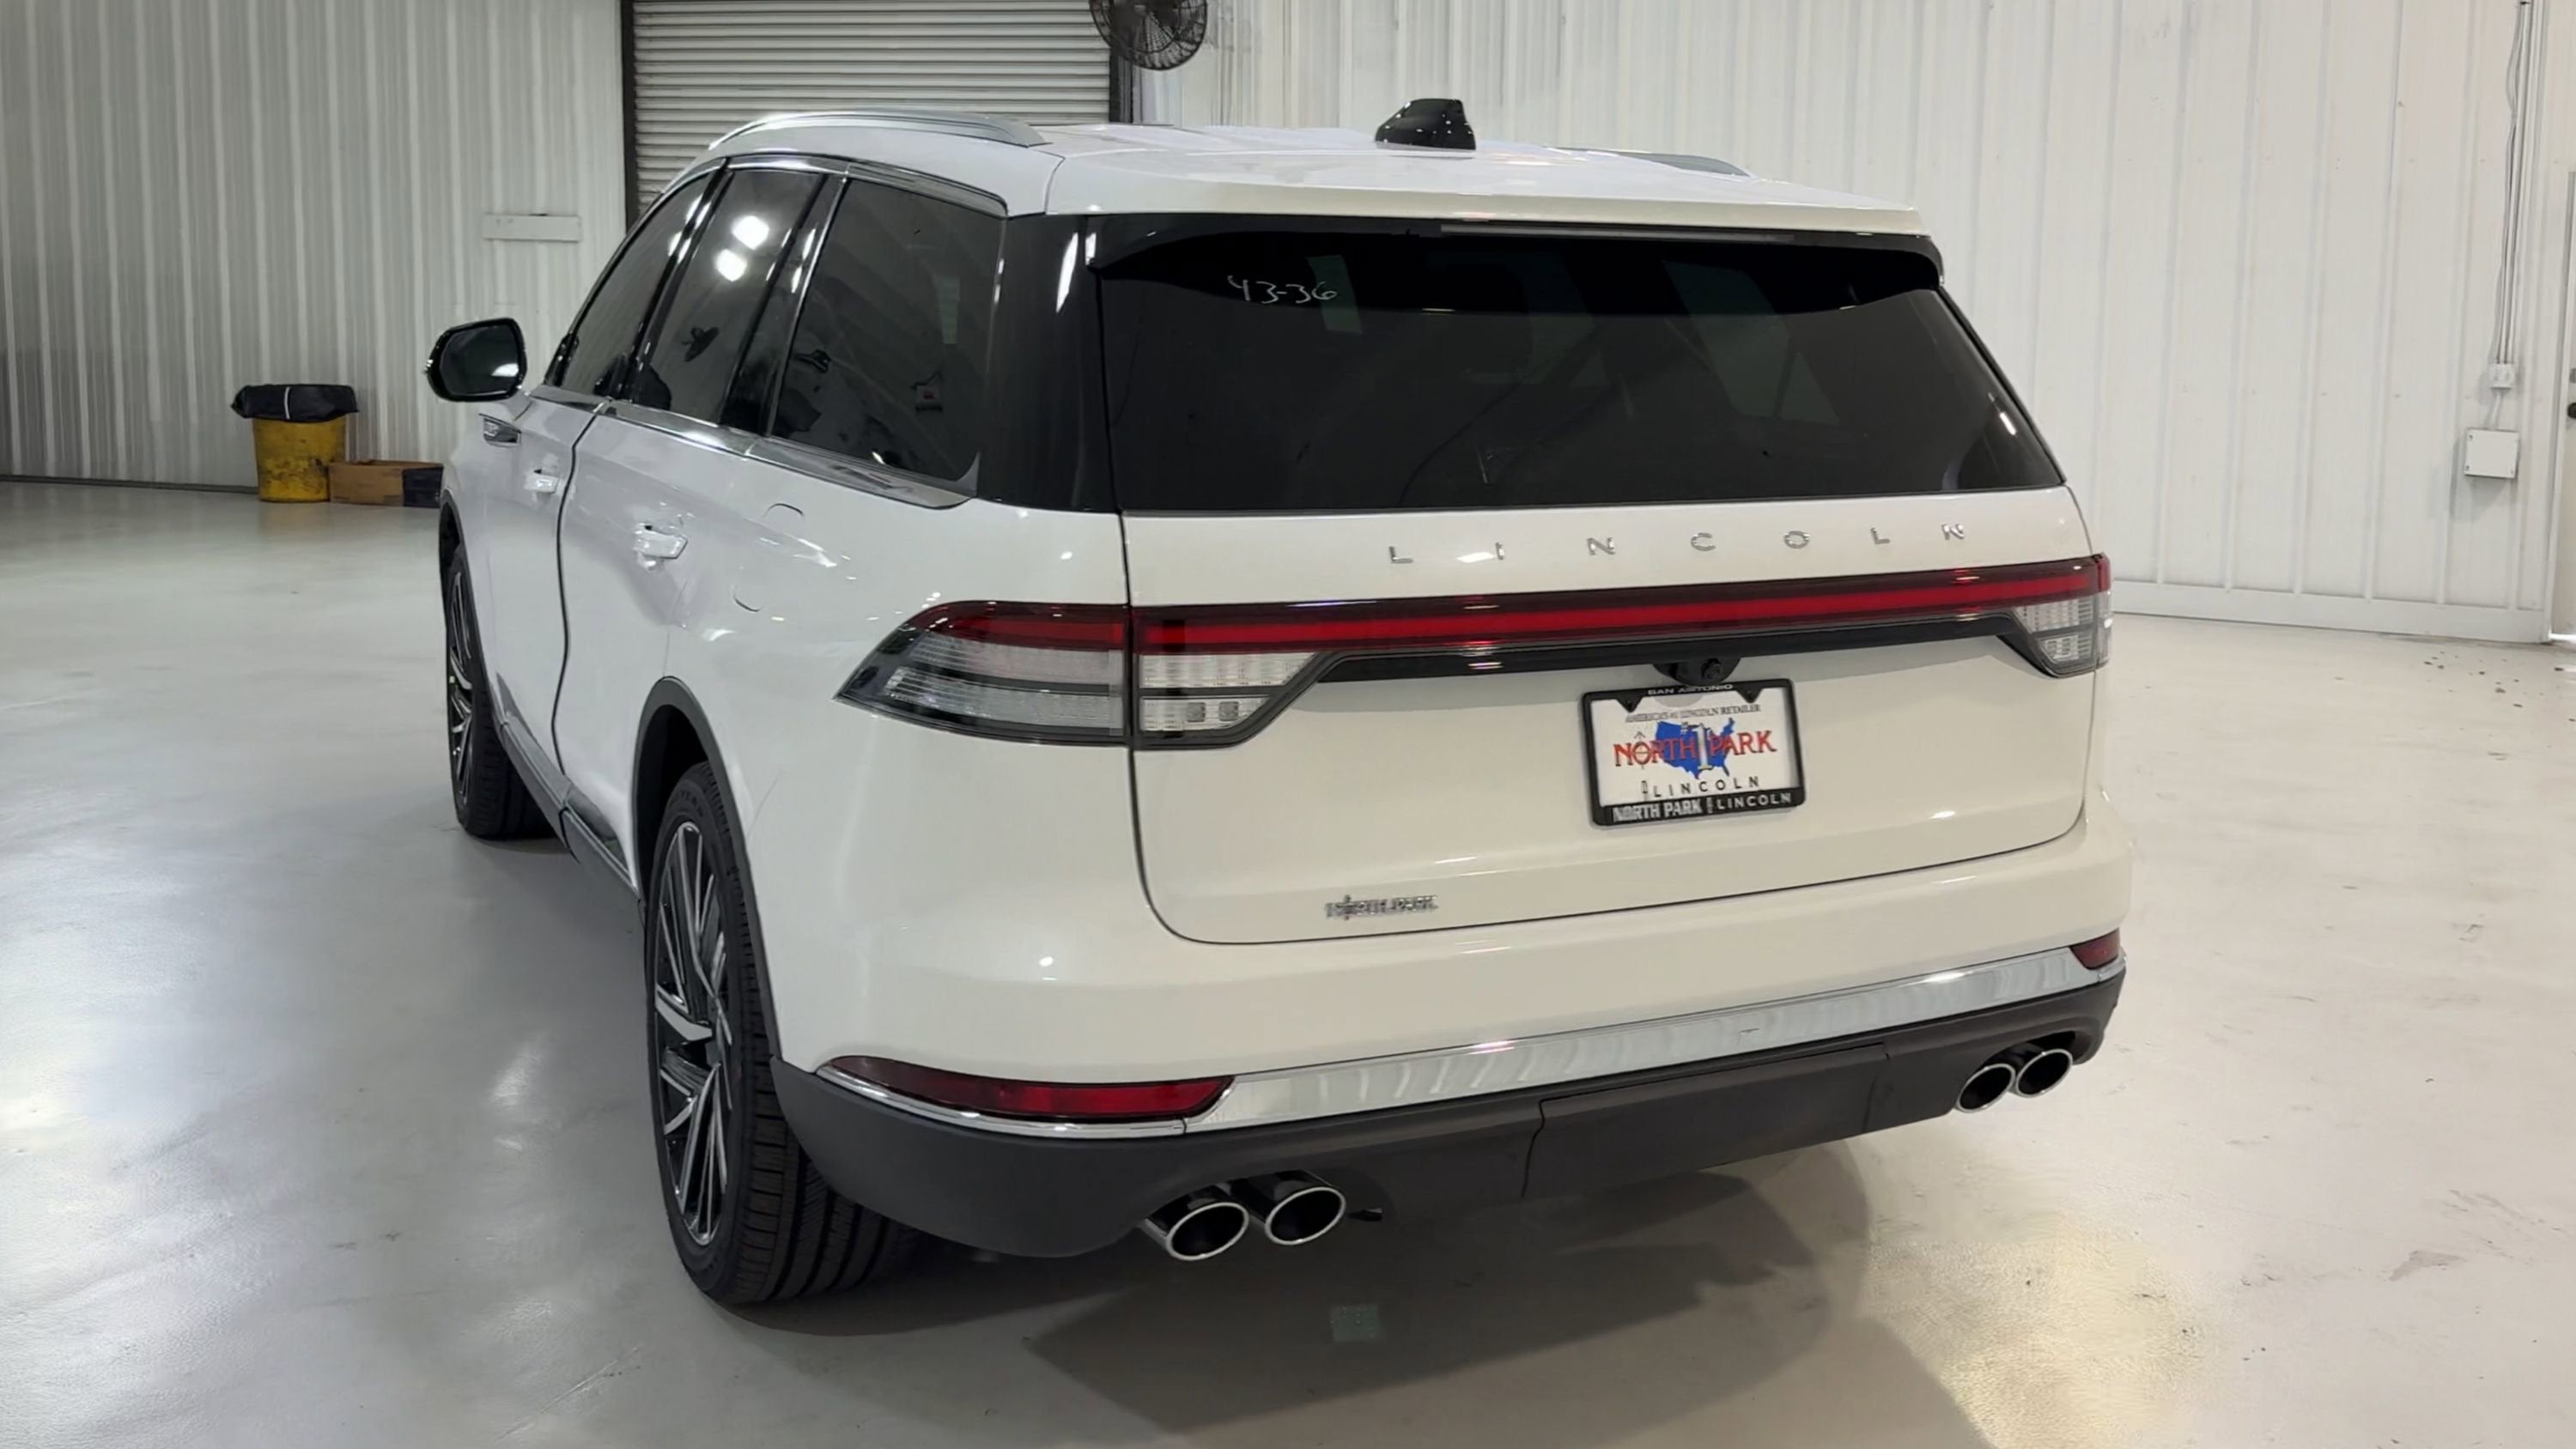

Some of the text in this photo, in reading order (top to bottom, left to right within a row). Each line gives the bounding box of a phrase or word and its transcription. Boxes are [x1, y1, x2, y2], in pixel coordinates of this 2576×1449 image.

[1228, 275, 1337, 304] 43-36
[1388, 524, 1965, 563] LINCOLN
[1721, 704, 1760, 714] RETAILER
[1613, 730, 1777, 767] NORTH PARK
[1653, 776, 1759, 797] LINCOLN
[1613, 792, 1791, 822] NORTH PARK LINCOLN
